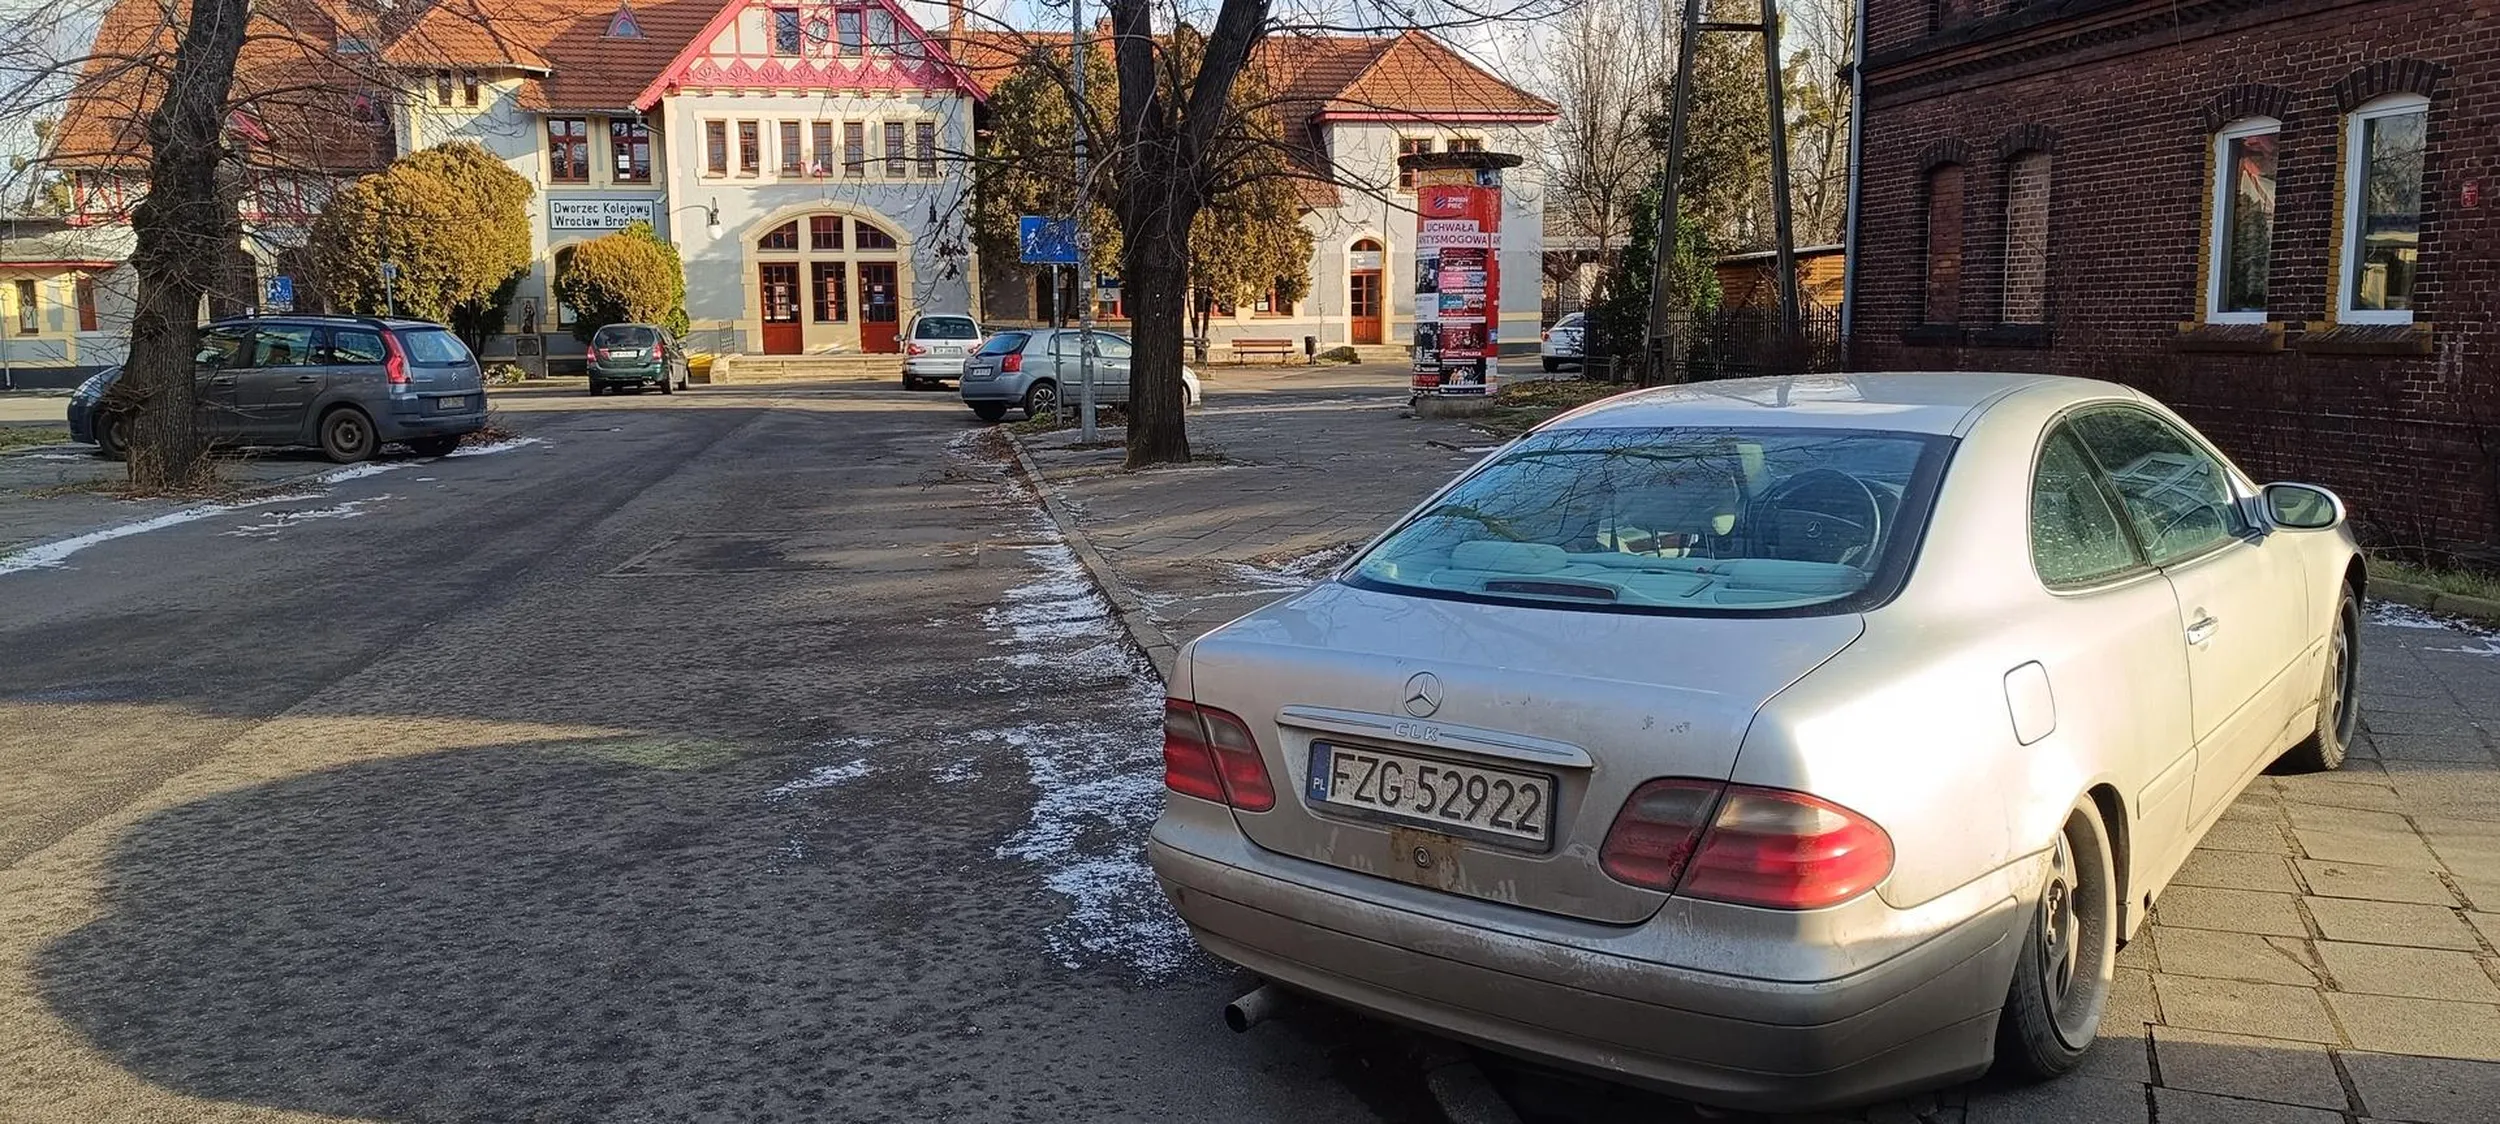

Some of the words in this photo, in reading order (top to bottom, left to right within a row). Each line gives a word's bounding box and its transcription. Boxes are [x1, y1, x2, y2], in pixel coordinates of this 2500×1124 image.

[554, 203, 598, 213] Dworzec
[603, 203, 650, 216] Kolejowy
[554, 216, 600, 226] Wrocław
[1426, 223, 1474, 232] UCHWAŁA
[1393, 722, 1439, 742] CLK
[1313, 777, 1325, 791] PL
[1330, 752, 1403, 807] FZG
[1415, 767, 1541, 832] 52922
